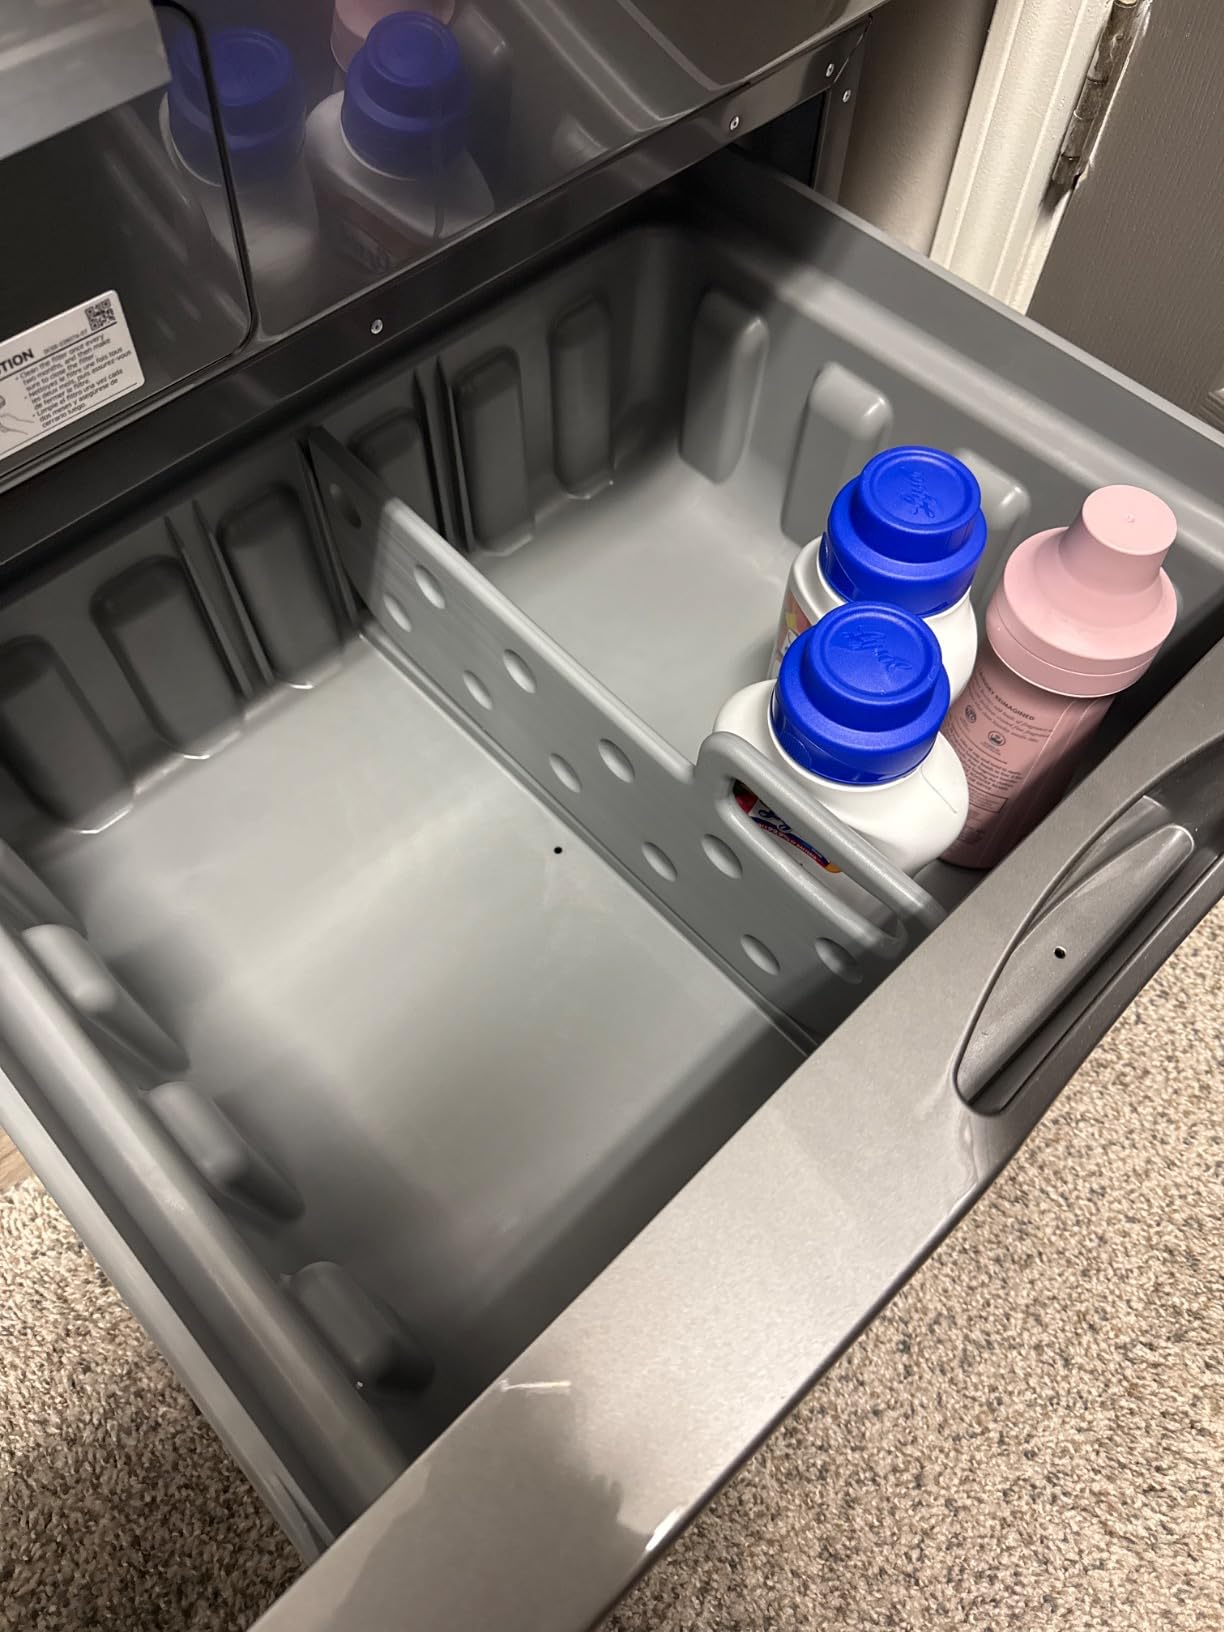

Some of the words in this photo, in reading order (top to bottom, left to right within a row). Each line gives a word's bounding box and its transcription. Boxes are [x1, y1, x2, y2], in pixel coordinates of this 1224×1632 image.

[68, 343, 84, 355] once
[85, 334, 104, 346] every
[77, 347, 92, 357] then
[93, 338, 110, 350] make
[0, 348, 34, 374] TION
[26, 381, 40, 391] sure
